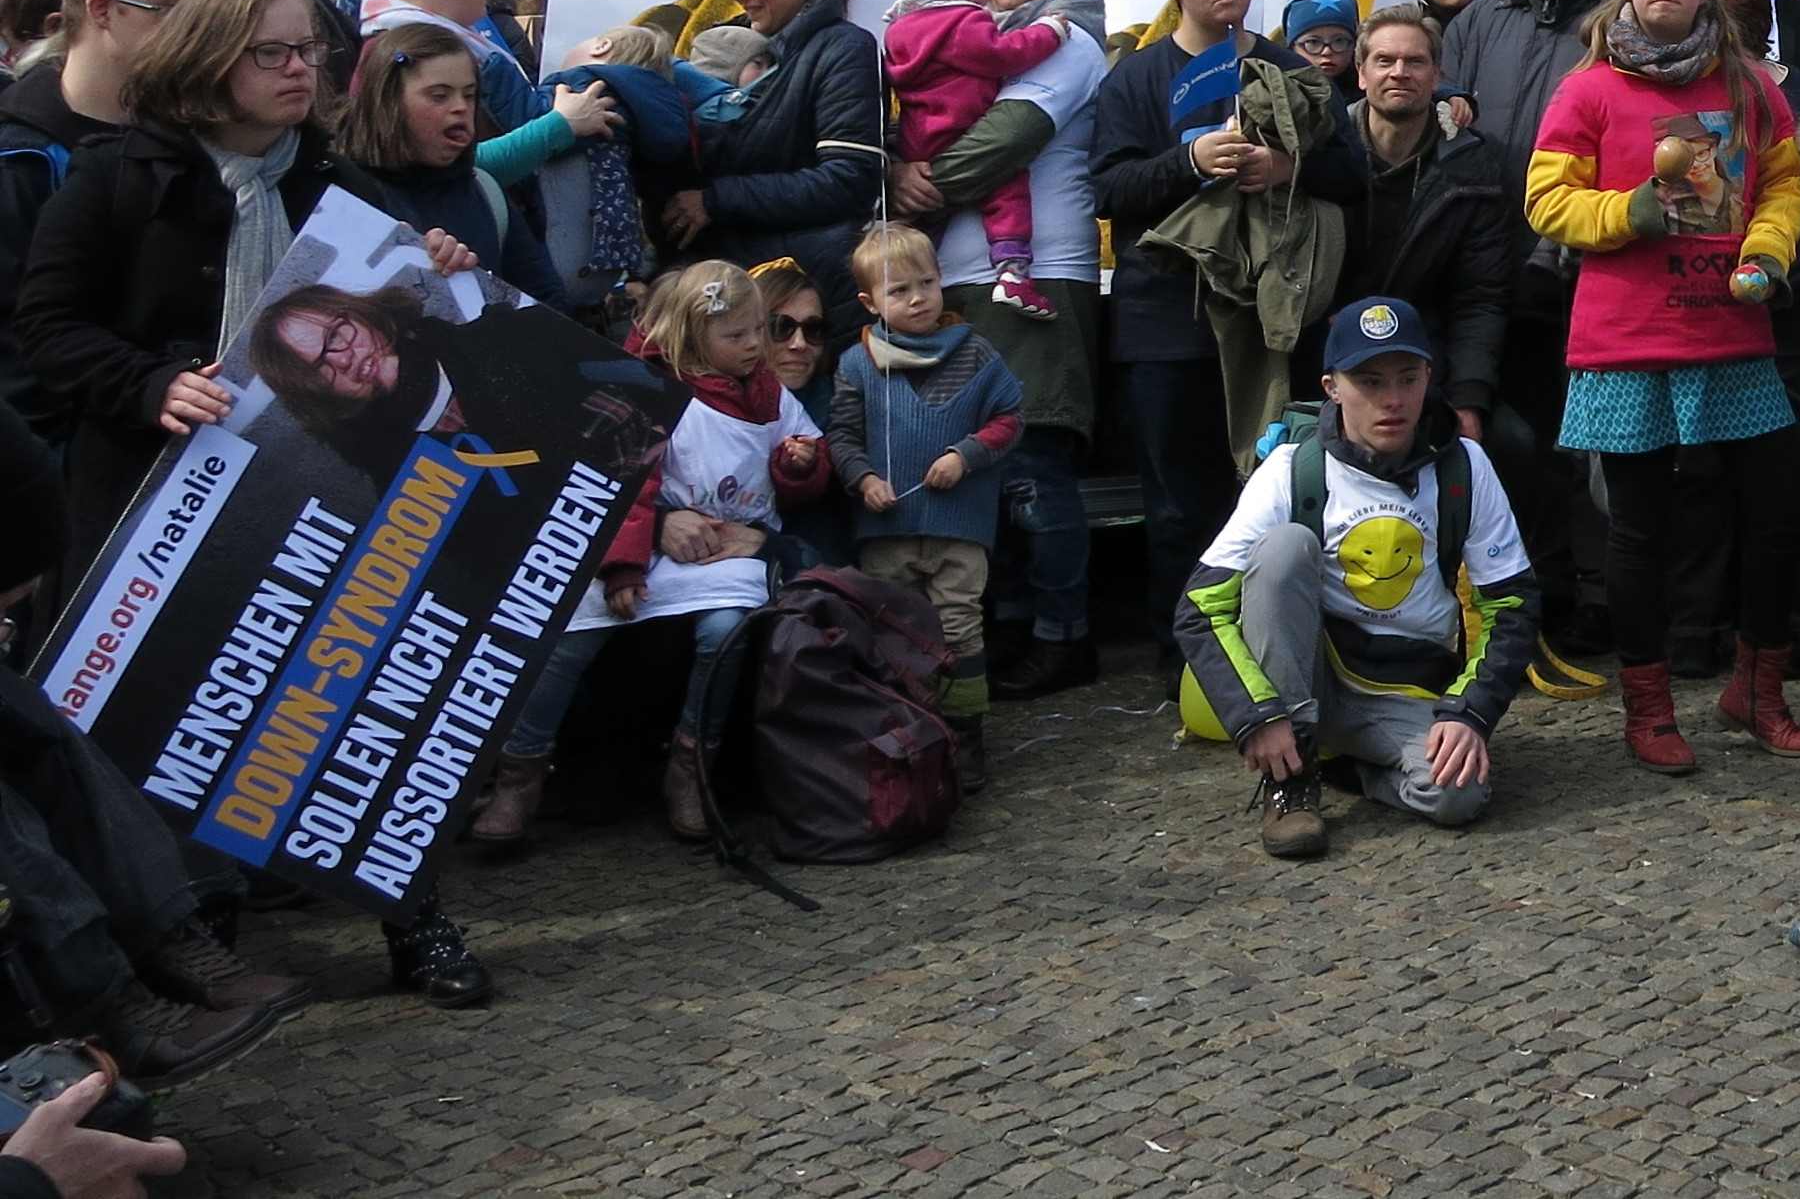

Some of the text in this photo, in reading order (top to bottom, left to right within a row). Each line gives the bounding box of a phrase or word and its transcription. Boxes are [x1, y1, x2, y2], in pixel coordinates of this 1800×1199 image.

[58, 455, 227, 718] ange.org /natalie
[142, 496, 357, 811] MENSCHEN MIT
[214, 456, 467, 841] DOWN-SYNDROM
[1379, 503, 1406, 514] MEIN
[286, 590, 470, 870] SOLLEN NICHT
[352, 460, 623, 900] AUSSORTIERT WERDEN!
